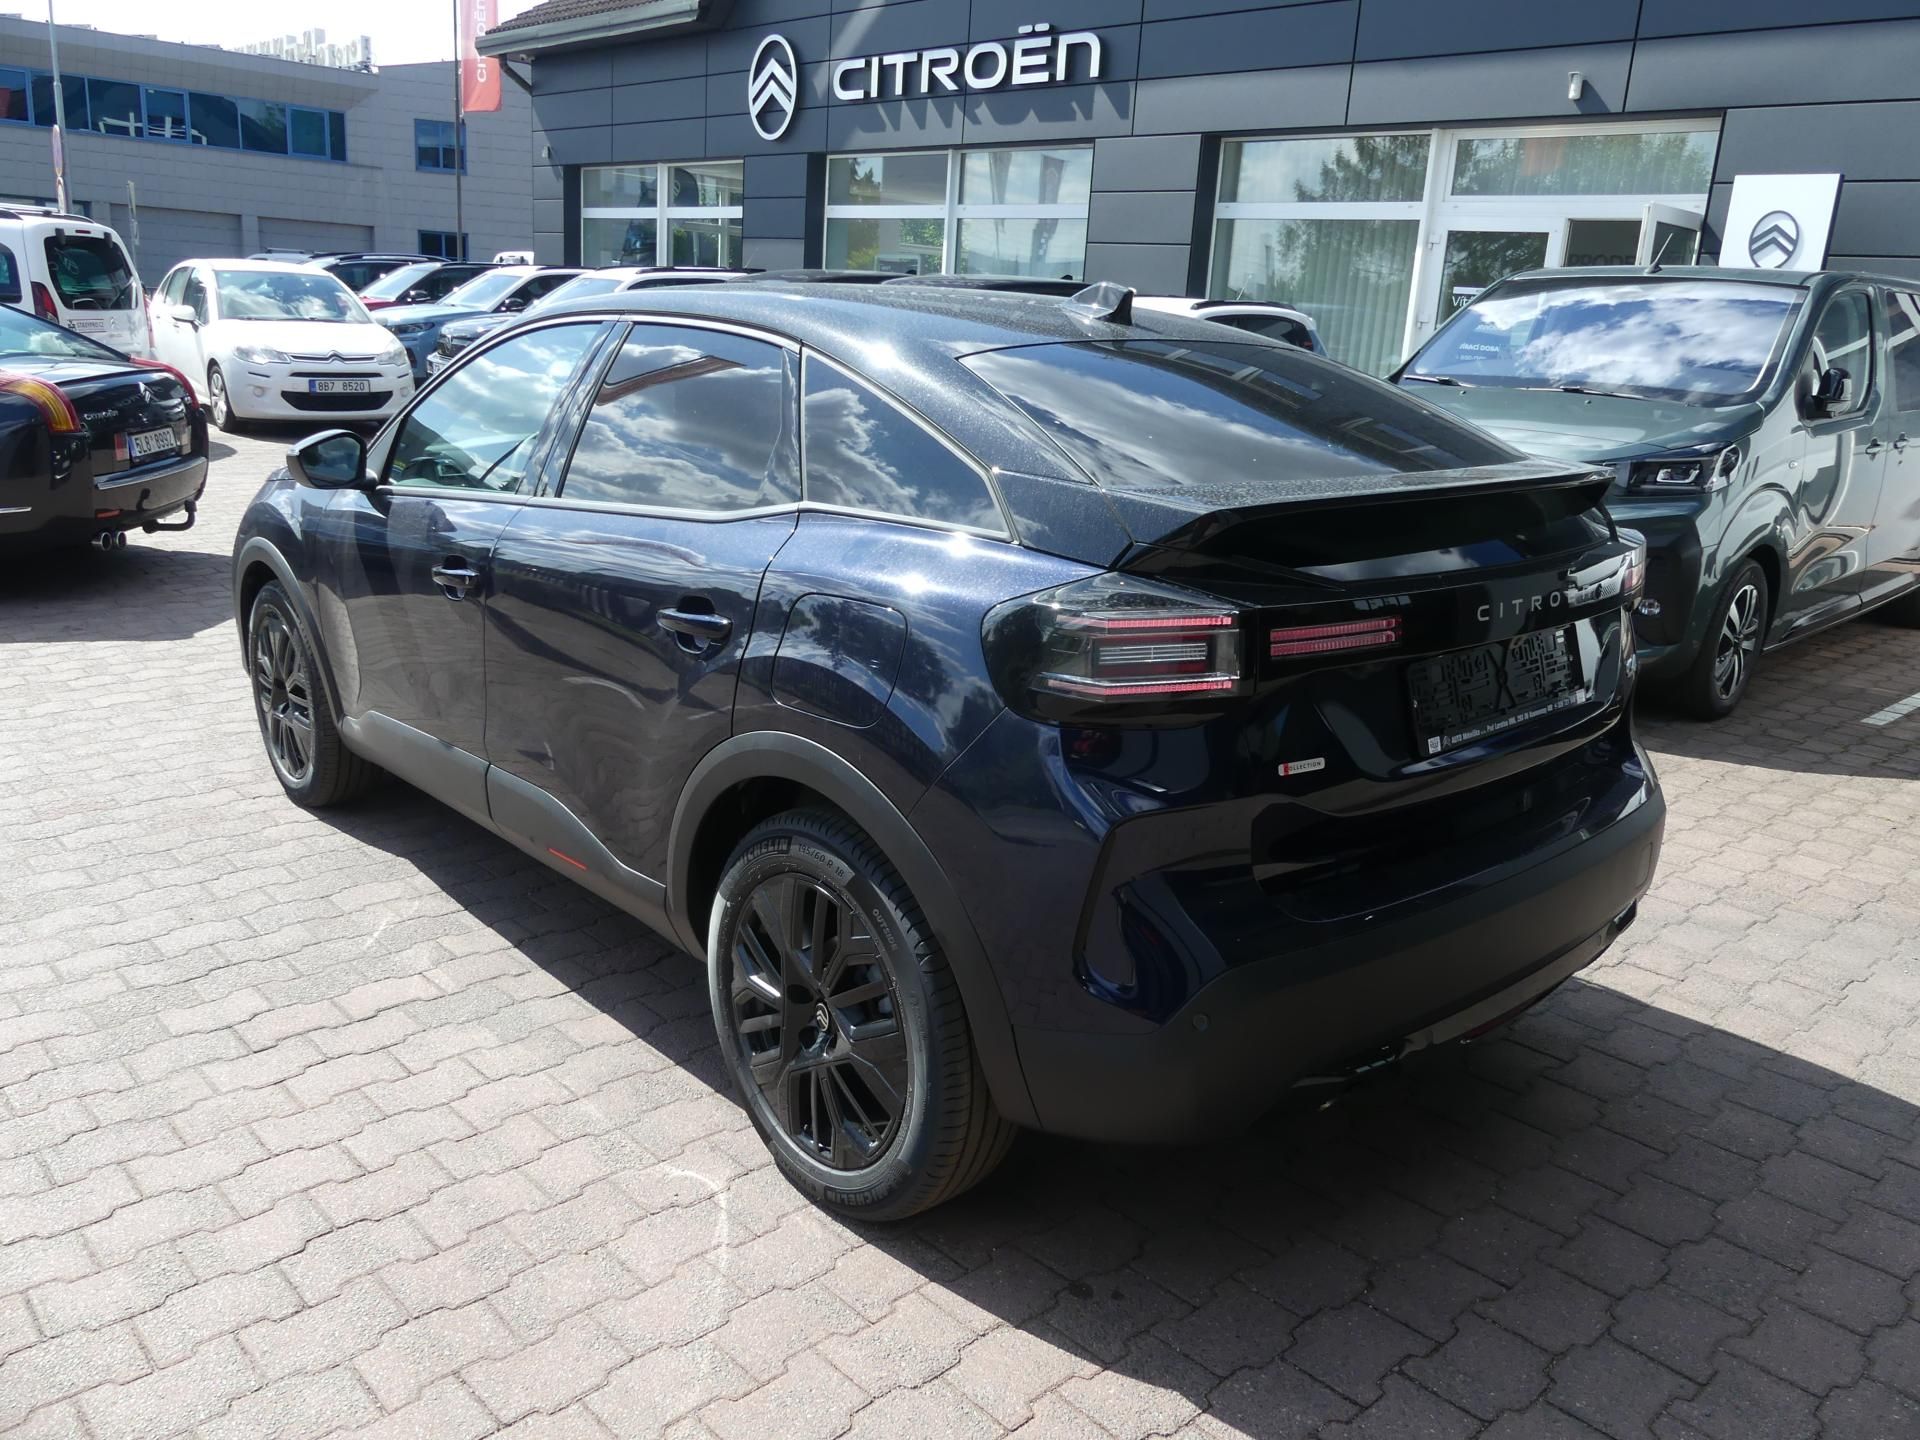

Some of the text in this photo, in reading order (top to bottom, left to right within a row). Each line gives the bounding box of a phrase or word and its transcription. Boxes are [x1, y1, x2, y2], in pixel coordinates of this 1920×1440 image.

[832, 22, 1101, 101] CITROËN
[318, 381, 365, 391] 8B7 8520
[134, 430, 175, 454] 5L8 8992
[826, 859, 833, 869] R
[835, 866, 845, 879] 18
[872, 908, 899, 951] OUTSIDE
